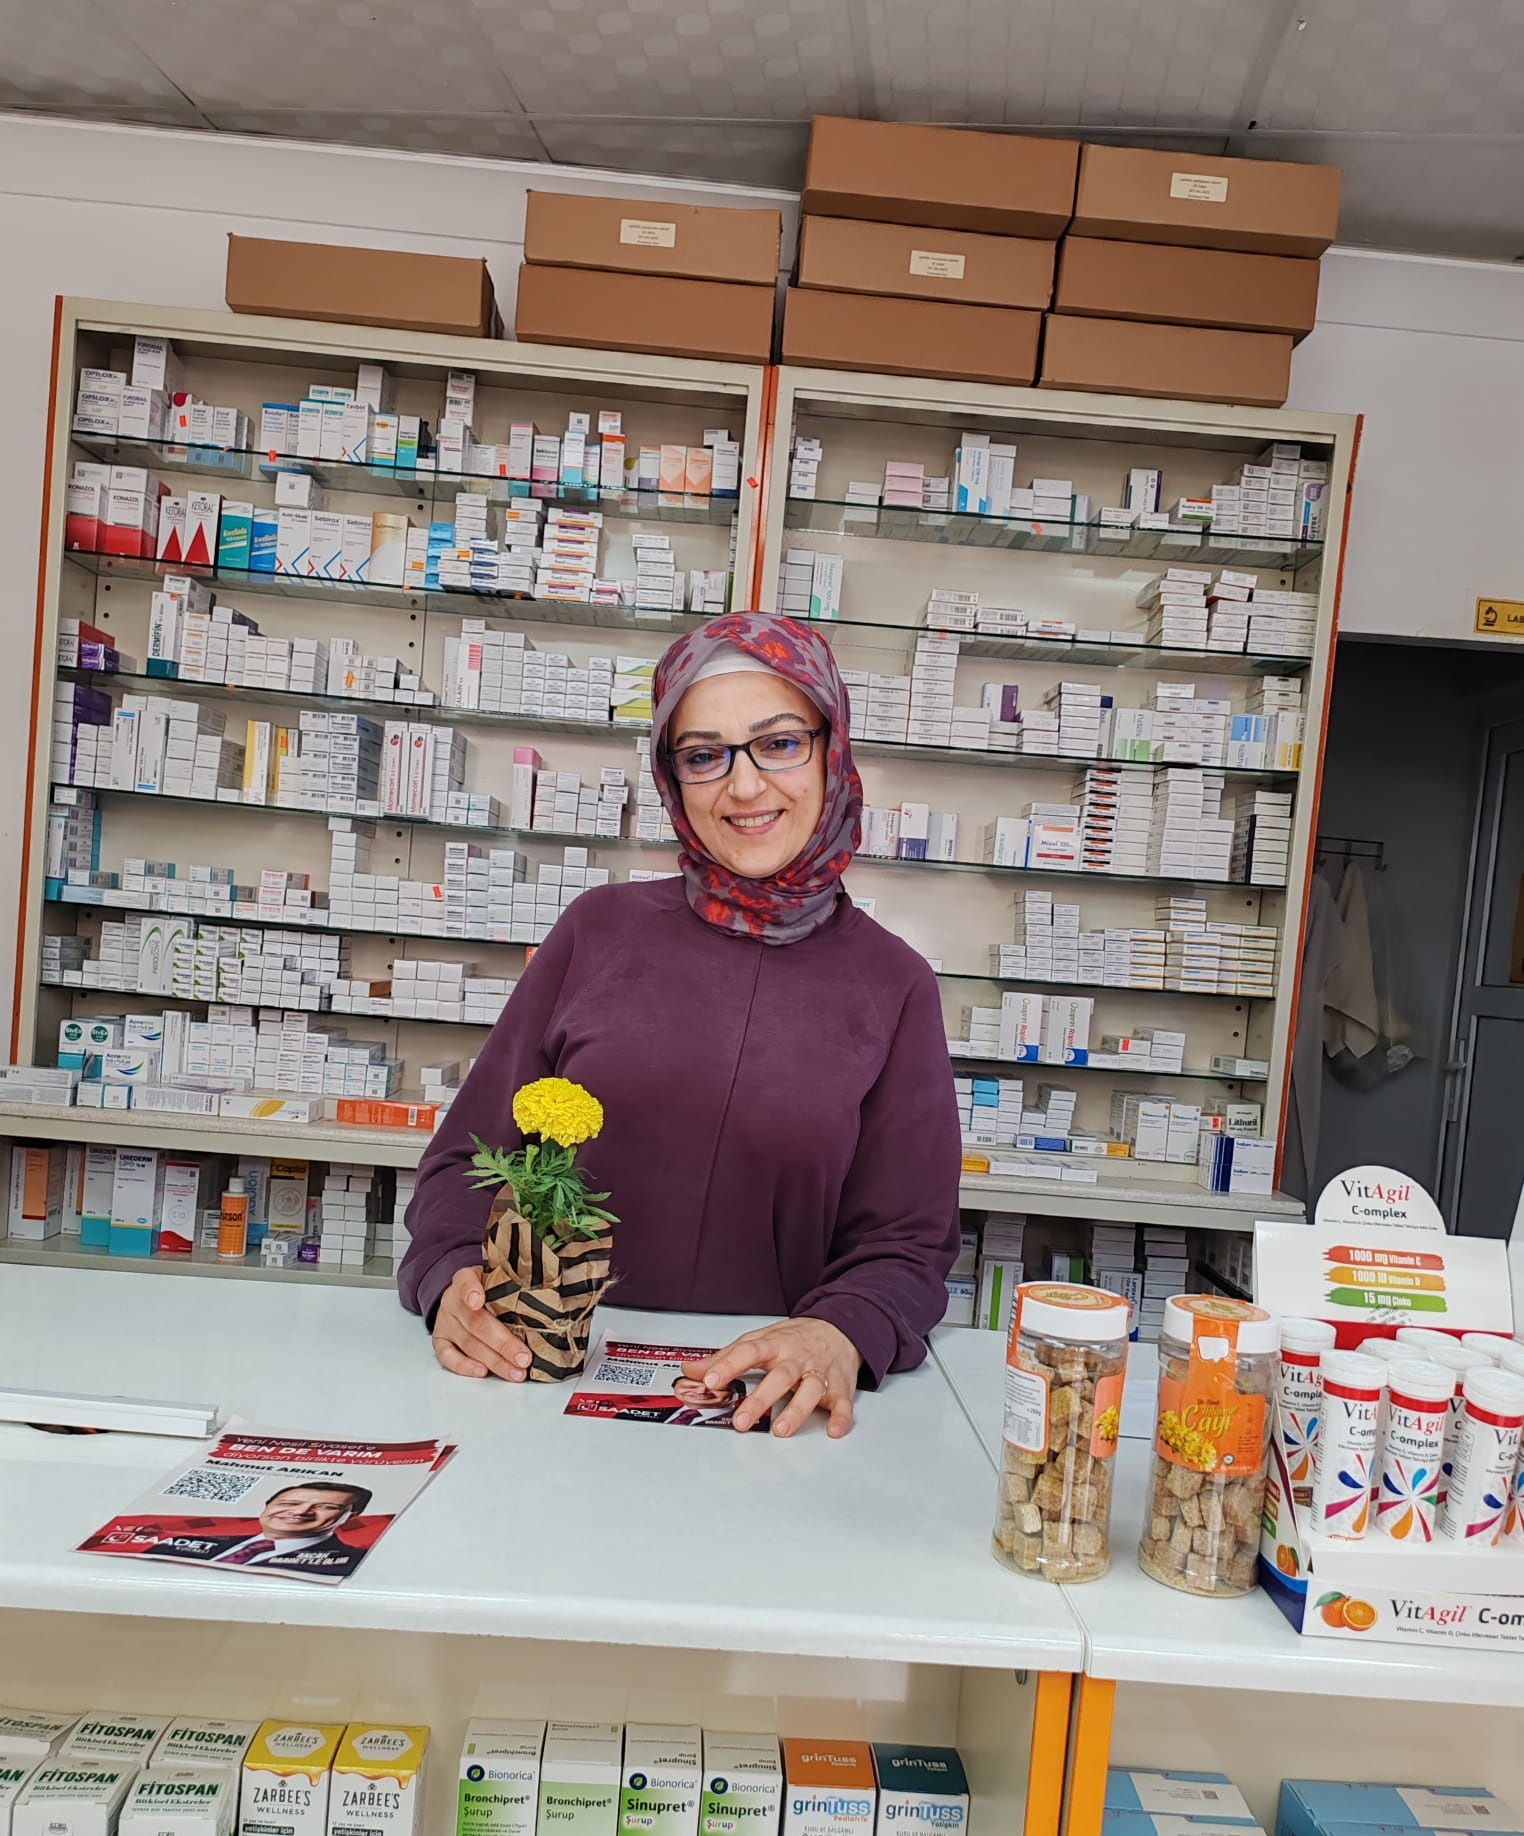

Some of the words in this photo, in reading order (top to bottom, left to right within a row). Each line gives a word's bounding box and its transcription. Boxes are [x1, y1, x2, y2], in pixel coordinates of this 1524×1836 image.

[165, 505, 186, 516] KETORA
[1066, 1028, 1076, 1048] Rapid
[90, 1147, 116, 1155] UREDER
[119, 1154, 153, 1163] UREDERM
[1340, 1179, 1411, 1204] VitAgil
[1352, 1205, 1408, 1220] C-omplex
[1349, 1249, 1373, 1262] 1000
[1375, 1252, 1389, 1265] mg
[1389, 1254, 1415, 1265] Vitamin
[1416, 1256, 1422, 1266] C
[1352, 1270, 1376, 1283] 1000
[1388, 1274, 1414, 1285] Vitamin
[1415, 1276, 1420, 1286] D
[1364, 1292, 1376, 1304] 15
[1377, 1294, 1391, 1307] mg
[616, 1347, 650, 1355] BEN
[607, 1357, 659, 1366] Mahmut
[1280, 1364, 1323, 1387] VitAg
[598, 1405, 662, 1417] SAADET
[237, 1437, 265, 1446] Yeni
[1390, 1430, 1439, 1449] C-omplex
[229, 1444, 276, 1453] BEN
[280, 1447, 312, 1455] DE
[316, 1450, 384, 1458] VARIM
[223, 1452, 291, 1460] diyorsan
[295, 1454, 347, 1463] birlikte
[205, 1459, 274, 1471] Mahmut
[277, 1467, 344, 1477] ARIKAN
[131, 1534, 219, 1551] SAADET
[1390, 1598, 1468, 1626] VitAgil
[1478, 1608, 1524, 1626] C-om
[0, 1717, 63, 1732] İTOSPAN
[80, 1722, 157, 1741] FİTOSPAN
[170, 1727, 247, 1747] FİTOSPAN
[75, 1736, 107, 1745] Bitkisel
[273, 1734, 320, 1745] ZARBEE'S
[360, 1737, 406, 1748] ZARBEE'S
[167, 1741, 198, 1751] Bitkisel
[801, 1753, 857, 1764] grinTuss
[892, 1757, 948, 1769] grinTuss
[39, 1769, 120, 1783] FİTOSPAN
[488, 1769, 533, 1781] Bionorica
[139, 1781, 220, 1796] FİTOSPAN
[650, 1778, 695, 1790] Bionorica
[731, 1782, 776, 1794] Bionorica
[253, 1787, 311, 1807] ZARBEE'S
[342, 1790, 401, 1810] ZARBEE'S
[256, 1806, 306, 1816] WELLNESS
[793, 1795, 872, 1816] grinTuss
[885, 1800, 964, 1822] grinTuss
[346, 1809, 395, 1819] WELLNESS
[463, 1806, 493, 1818] Şurup
[545, 1809, 575, 1821] Şurup
[625, 1814, 653, 1826] Şurup
[706, 1818, 734, 1830] Şurup
